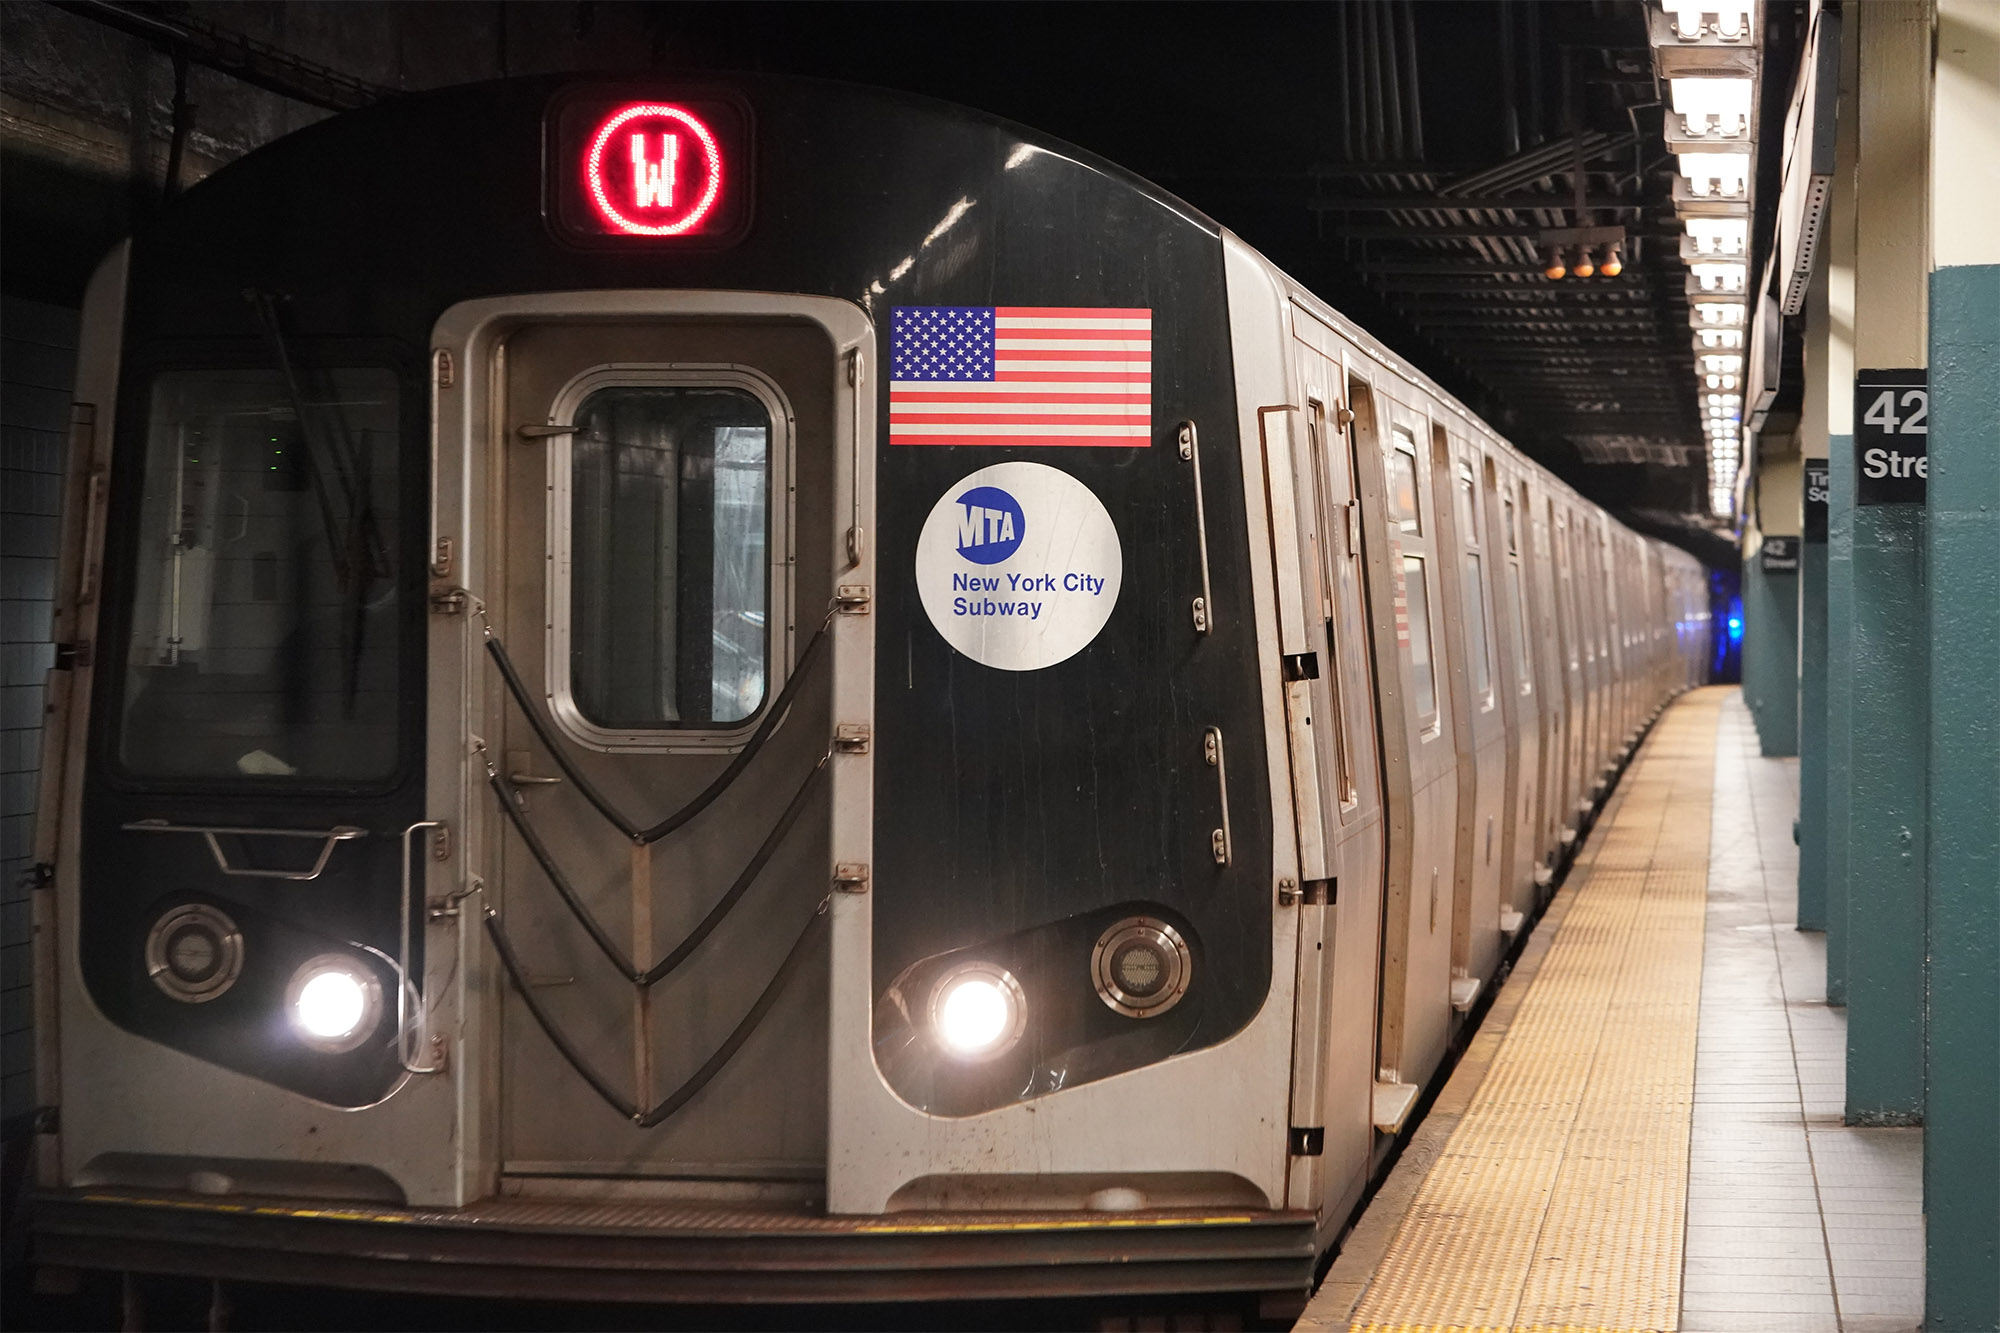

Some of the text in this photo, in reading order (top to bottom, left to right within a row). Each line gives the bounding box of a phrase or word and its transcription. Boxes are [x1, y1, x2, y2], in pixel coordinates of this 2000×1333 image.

[632, 134, 677, 208] W
[1864, 390, 1928, 434] 42
[1863, 448, 1928, 479] Stre
[955, 501, 1015, 550] MTA
[953, 573, 1105, 595] New York City
[953, 597, 1042, 619] Subway
